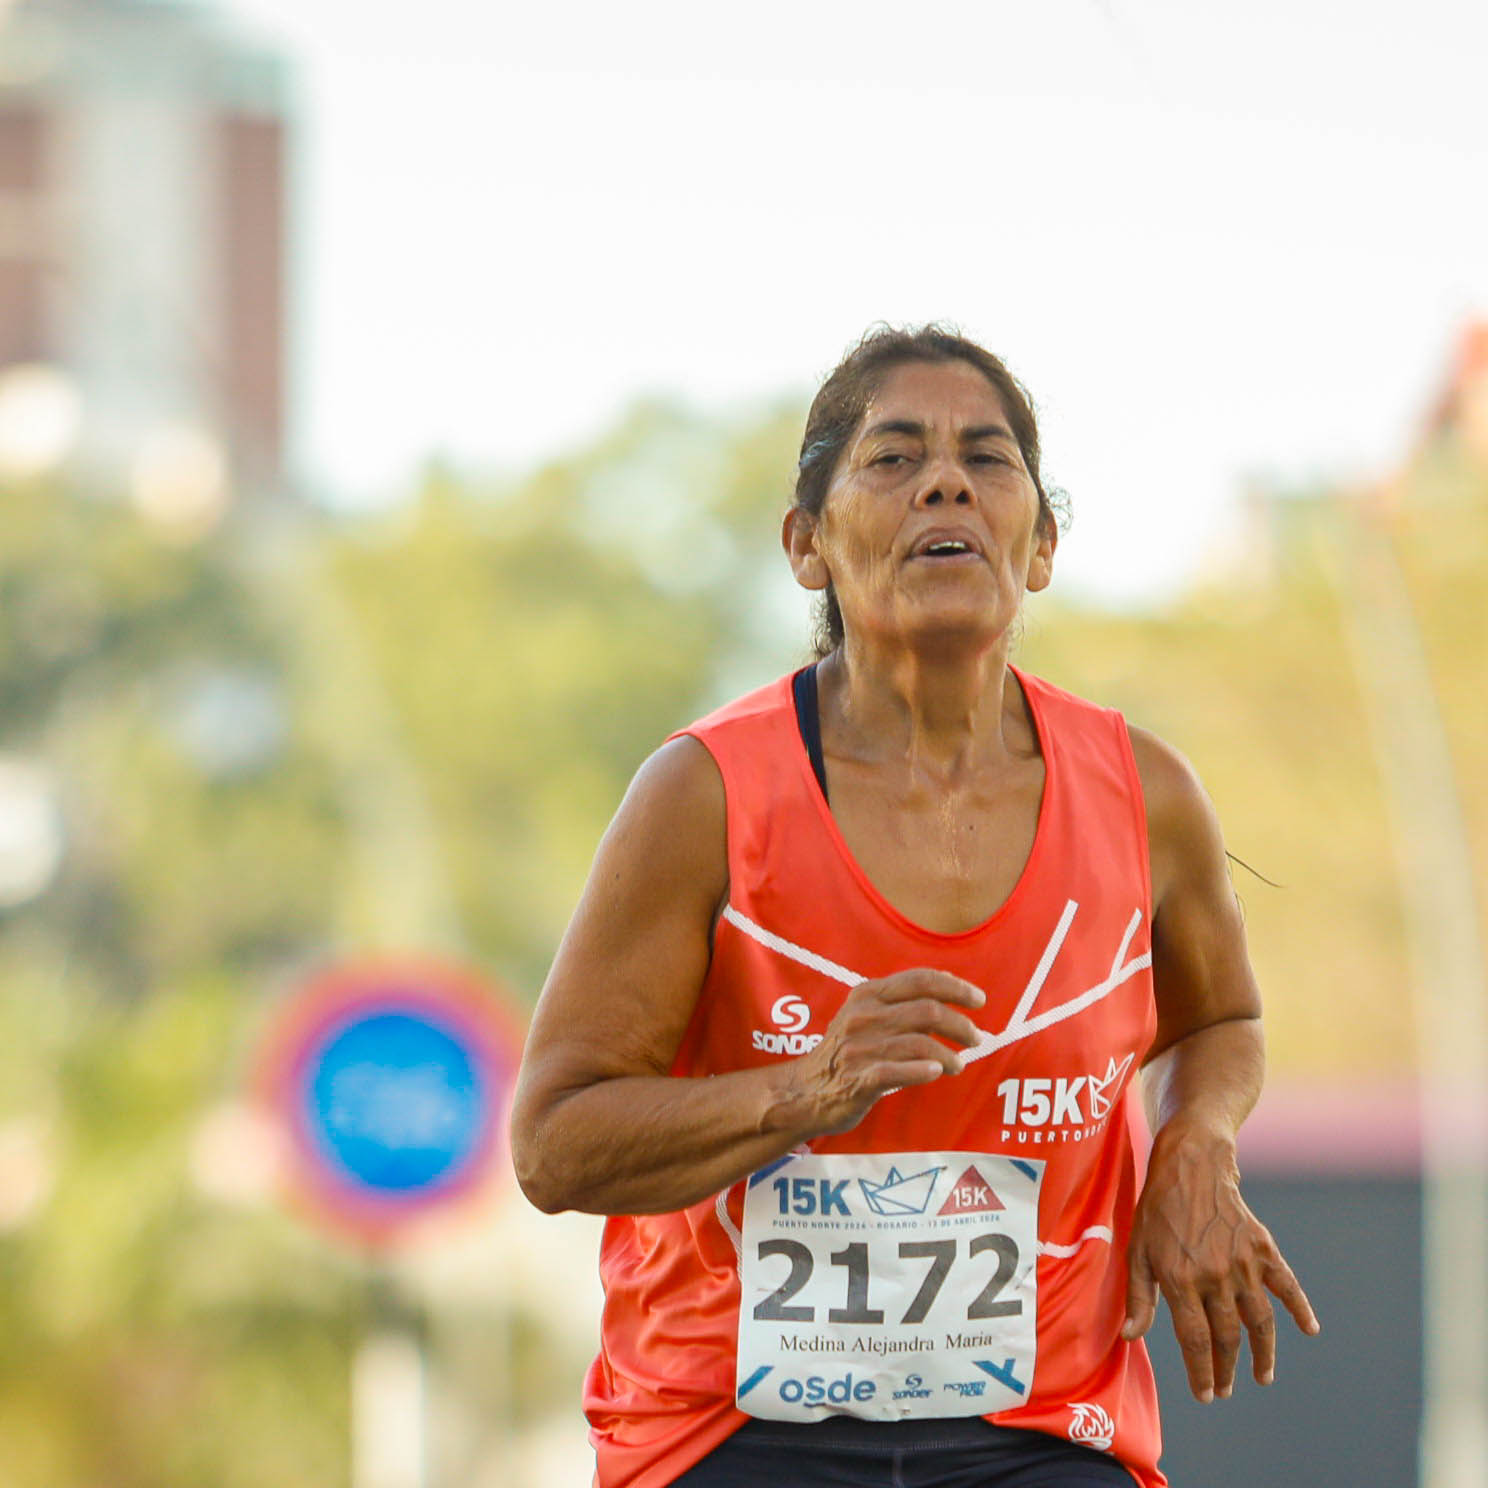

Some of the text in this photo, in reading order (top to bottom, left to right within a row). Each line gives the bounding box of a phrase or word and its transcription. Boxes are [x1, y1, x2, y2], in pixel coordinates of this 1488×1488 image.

[997, 1076, 1088, 1127] 15K
[773, 1176, 853, 1217] 15K
[953, 1185, 989, 1209] 15K
[772, 1219, 808, 1230] PUERTO
[811, 1221, 841, 1230] NORTE
[877, 1221, 918, 1230] ROSARIO
[941, 1219, 951, 1228] DE
[955, 1216, 977, 1226] ABRIL
[752, 1232, 1024, 1326] 2172
[779, 1331, 993, 1357] Medina Alejandra Maria
[779, 1371, 877, 1405] osde
